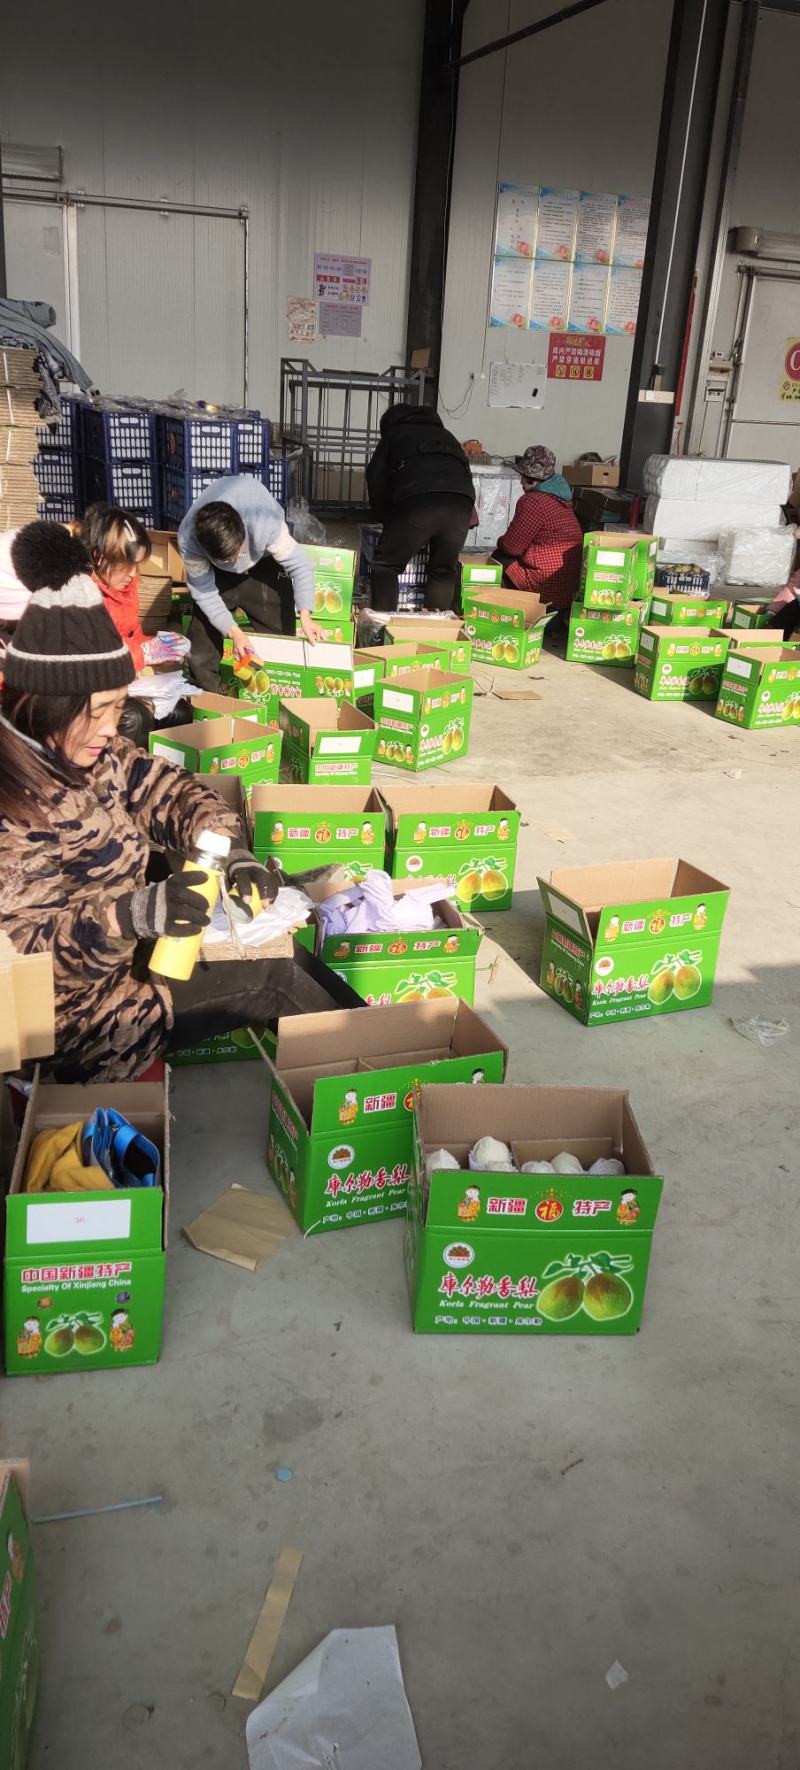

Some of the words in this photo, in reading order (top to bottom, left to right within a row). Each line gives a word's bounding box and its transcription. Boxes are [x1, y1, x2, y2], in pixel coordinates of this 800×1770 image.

[622, 919, 645, 933] 新疆
[364, 1093, 397, 1113] 新疆
[487, 1197, 527, 1216] 新疆
[537, 1200, 561, 1220] 福
[572, 1200, 613, 1217] 特产
[21, 1262, 132, 1283] 中国新疆特产
[21, 1284, 59, 1294] Specialty
[61, 1282, 71, 1290] Of
[73, 1280, 106, 1290] Xinjiang
[108, 1278, 132, 1287] China
[440, 1299, 464, 1308] Korla
[469, 1300, 509, 1309] Fragrant
[513, 1301, 535, 1309] Pear
